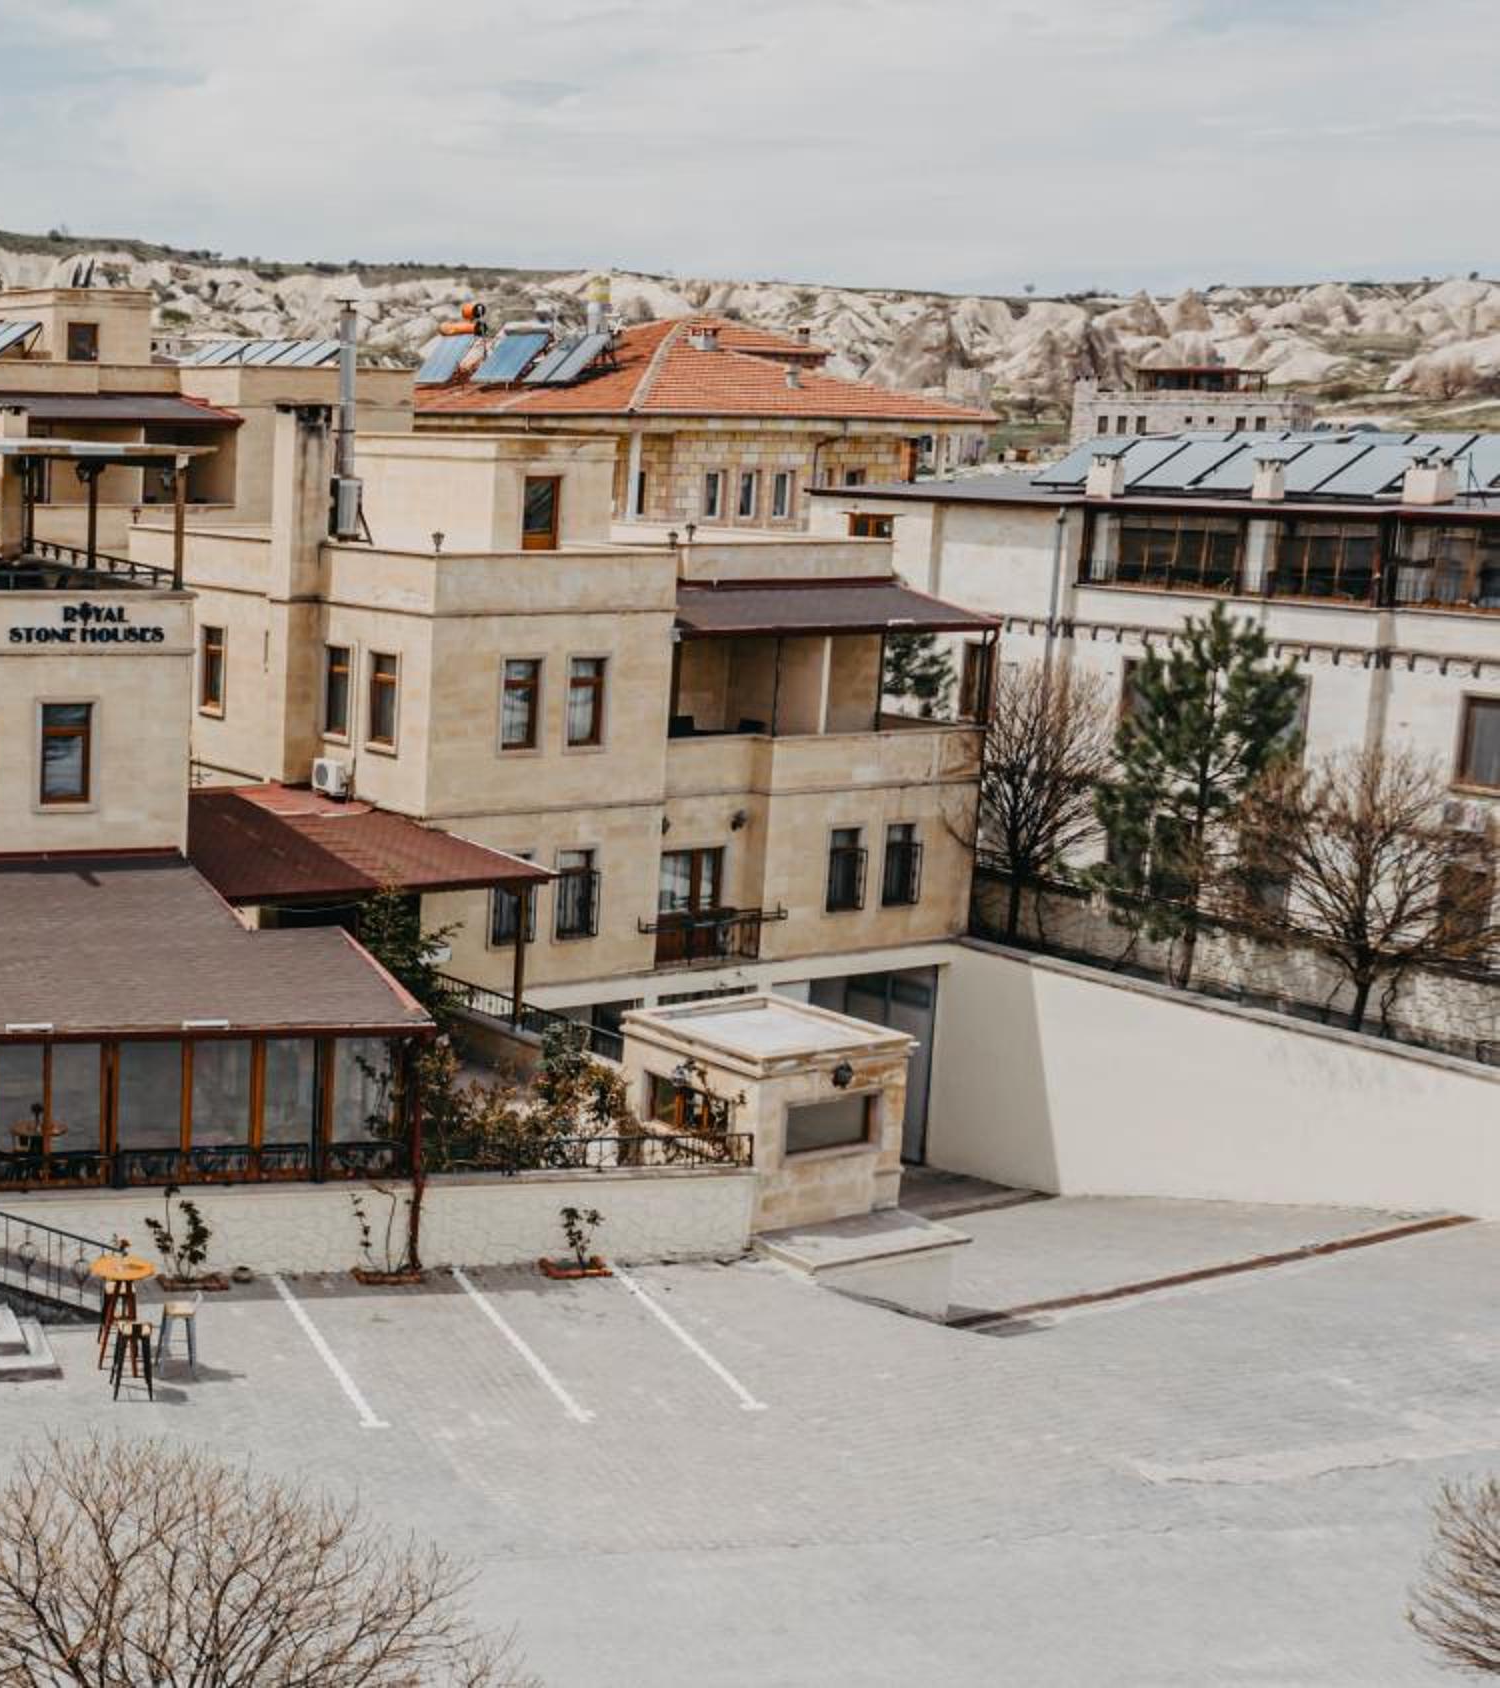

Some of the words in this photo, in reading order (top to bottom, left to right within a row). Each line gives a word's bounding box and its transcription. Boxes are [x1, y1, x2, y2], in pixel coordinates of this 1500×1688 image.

[62, 602, 130, 625] ROYAL
[9, 627, 76, 643] STONE
[80, 627, 165, 643] HOUSES
